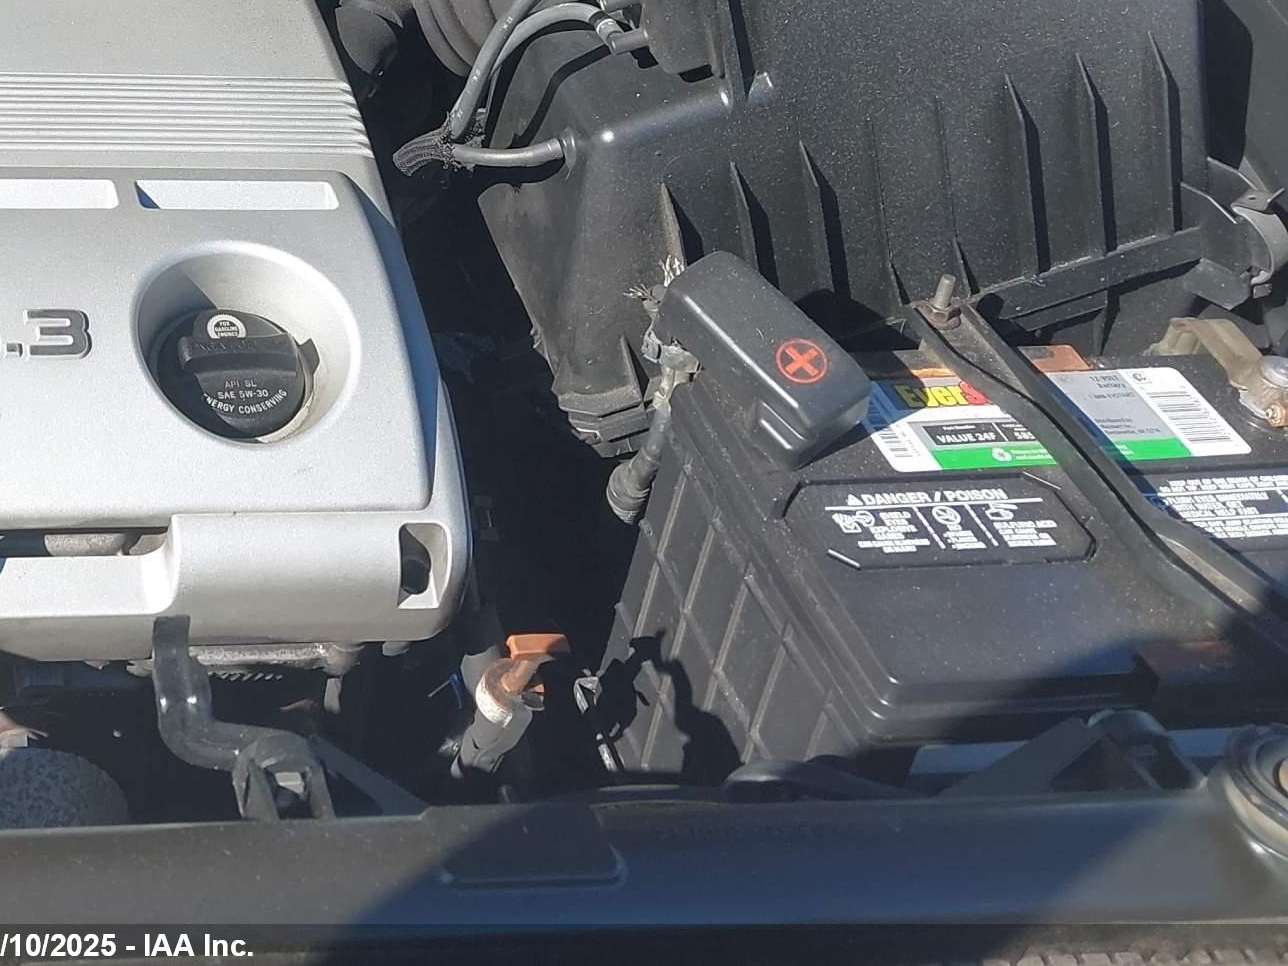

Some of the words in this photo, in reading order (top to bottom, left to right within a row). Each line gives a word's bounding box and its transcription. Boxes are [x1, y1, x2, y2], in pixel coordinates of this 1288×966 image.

[225, 379, 240, 389] API
[245, 379, 257, 388] SL
[217, 391, 237, 400] SAE
[239, 389, 269, 400] 5W-30
[238, 389, 288, 414] CONSERVING
[894, 381, 987, 408] EverS
[936, 434, 976, 444] VALUE
[976, 432, 996, 441] 24F
[861, 491, 932, 505] DANGER
[943, 488, 1008, 502] POISON
